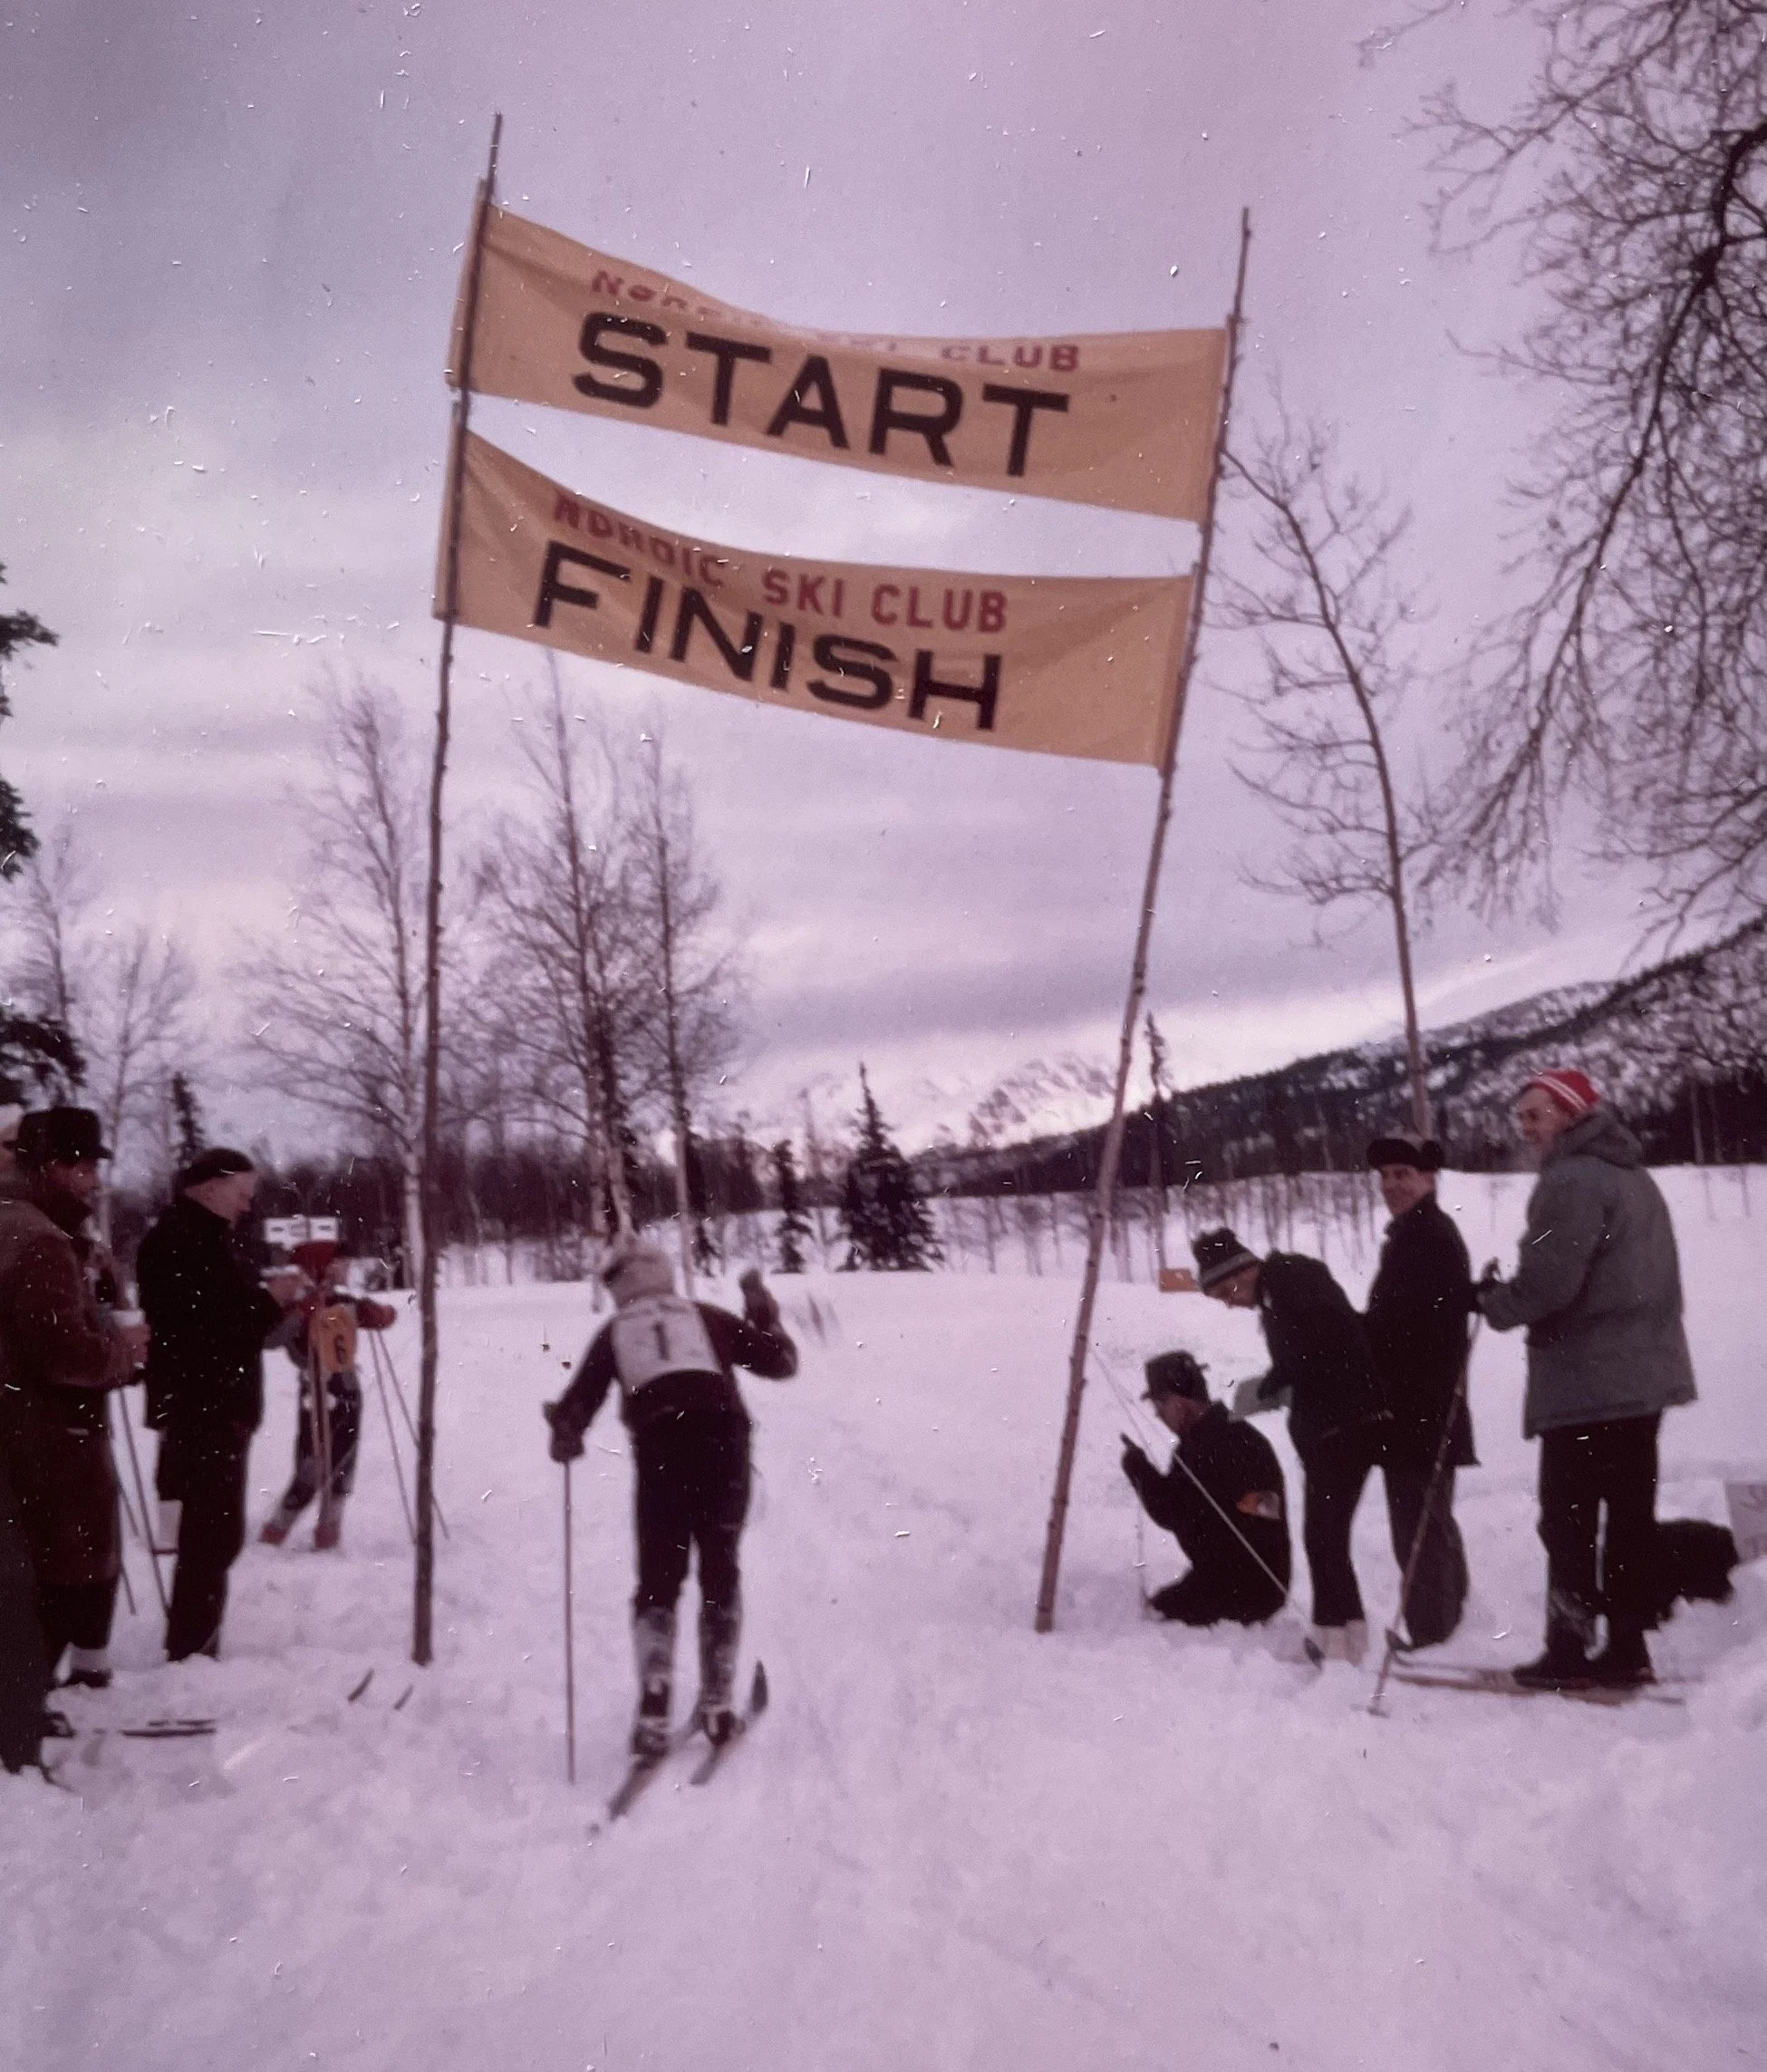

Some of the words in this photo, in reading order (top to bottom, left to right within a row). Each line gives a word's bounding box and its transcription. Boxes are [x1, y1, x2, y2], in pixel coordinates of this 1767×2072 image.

[571, 311, 1070, 478] START
[940, 344, 1079, 373] CLUB
[554, 490, 726, 586] NORDIC
[762, 566, 845, 618] SKI
[871, 584, 1008, 634] CLUB
[532, 539, 1003, 731] FINISH
[652, 1321, 669, 1360] 1
